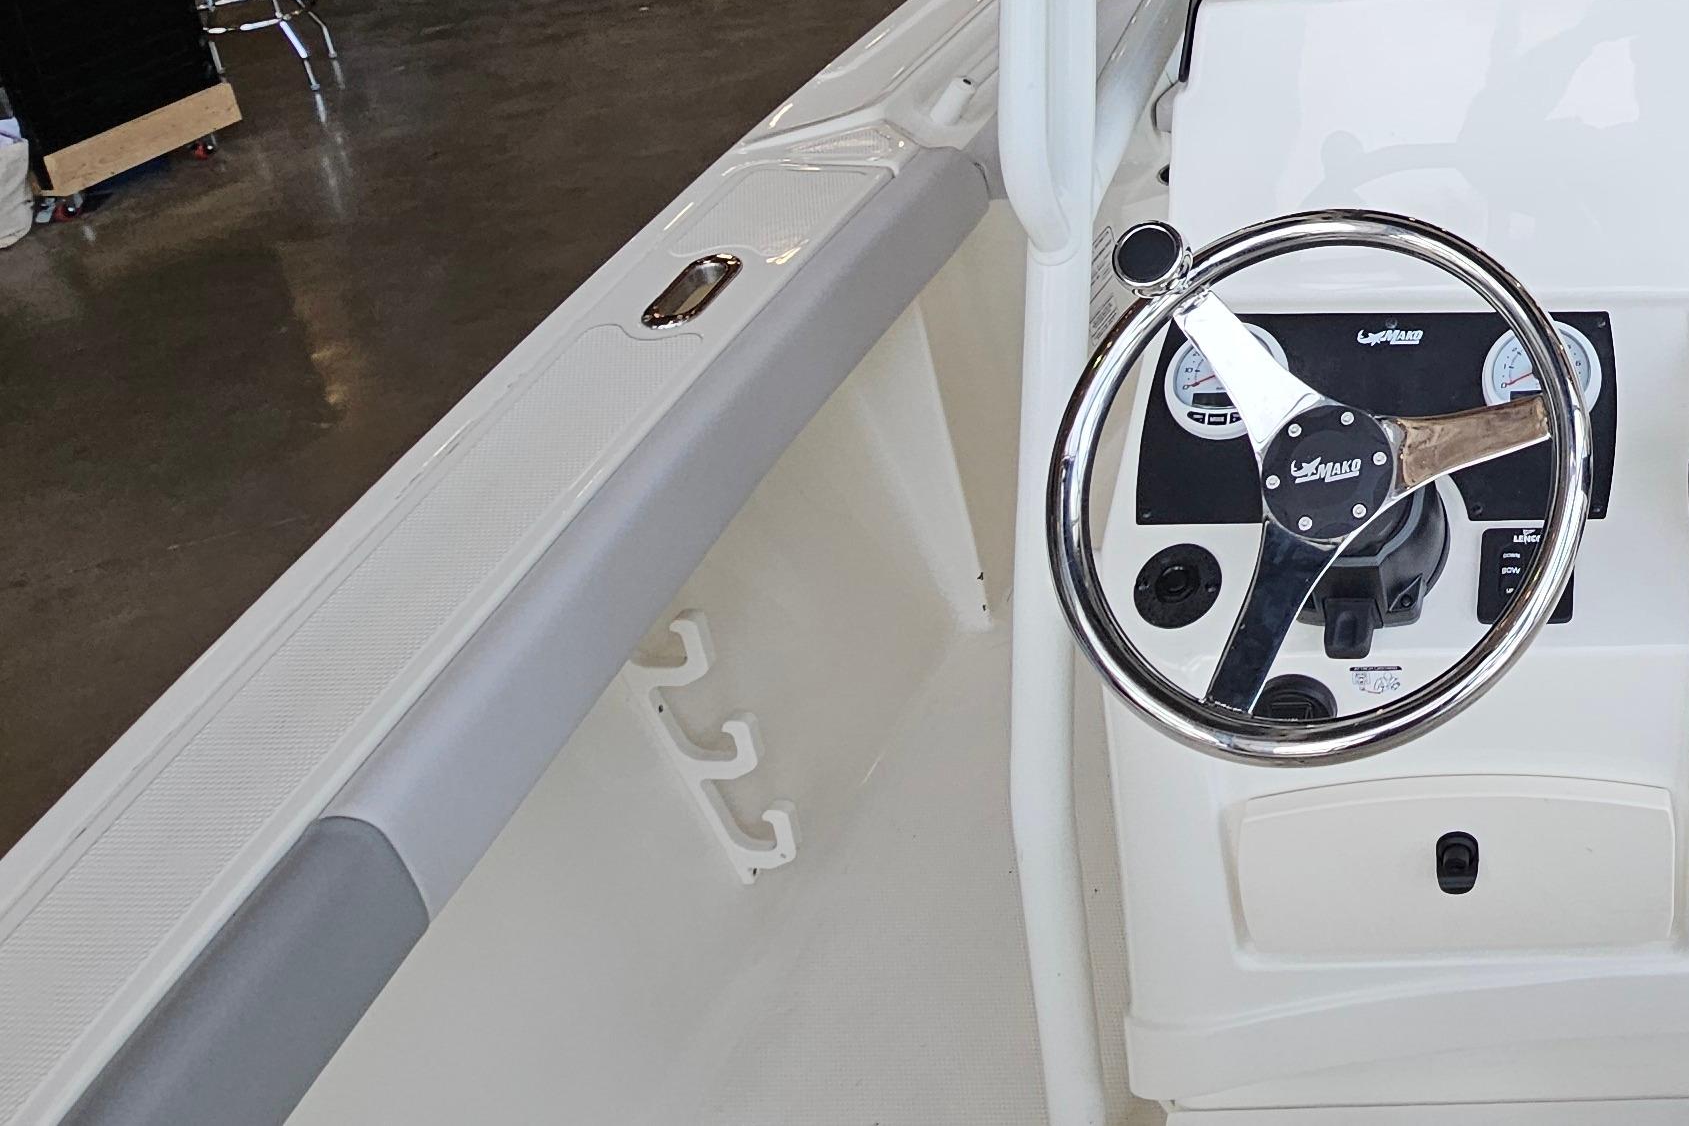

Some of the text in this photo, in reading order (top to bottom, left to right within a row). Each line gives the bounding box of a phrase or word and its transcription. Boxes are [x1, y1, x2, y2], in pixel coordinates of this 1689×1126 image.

[1386, 330, 1424, 344] MAKO
[1318, 458, 1362, 483] MAKO
[1502, 567, 1521, 575] BOW
